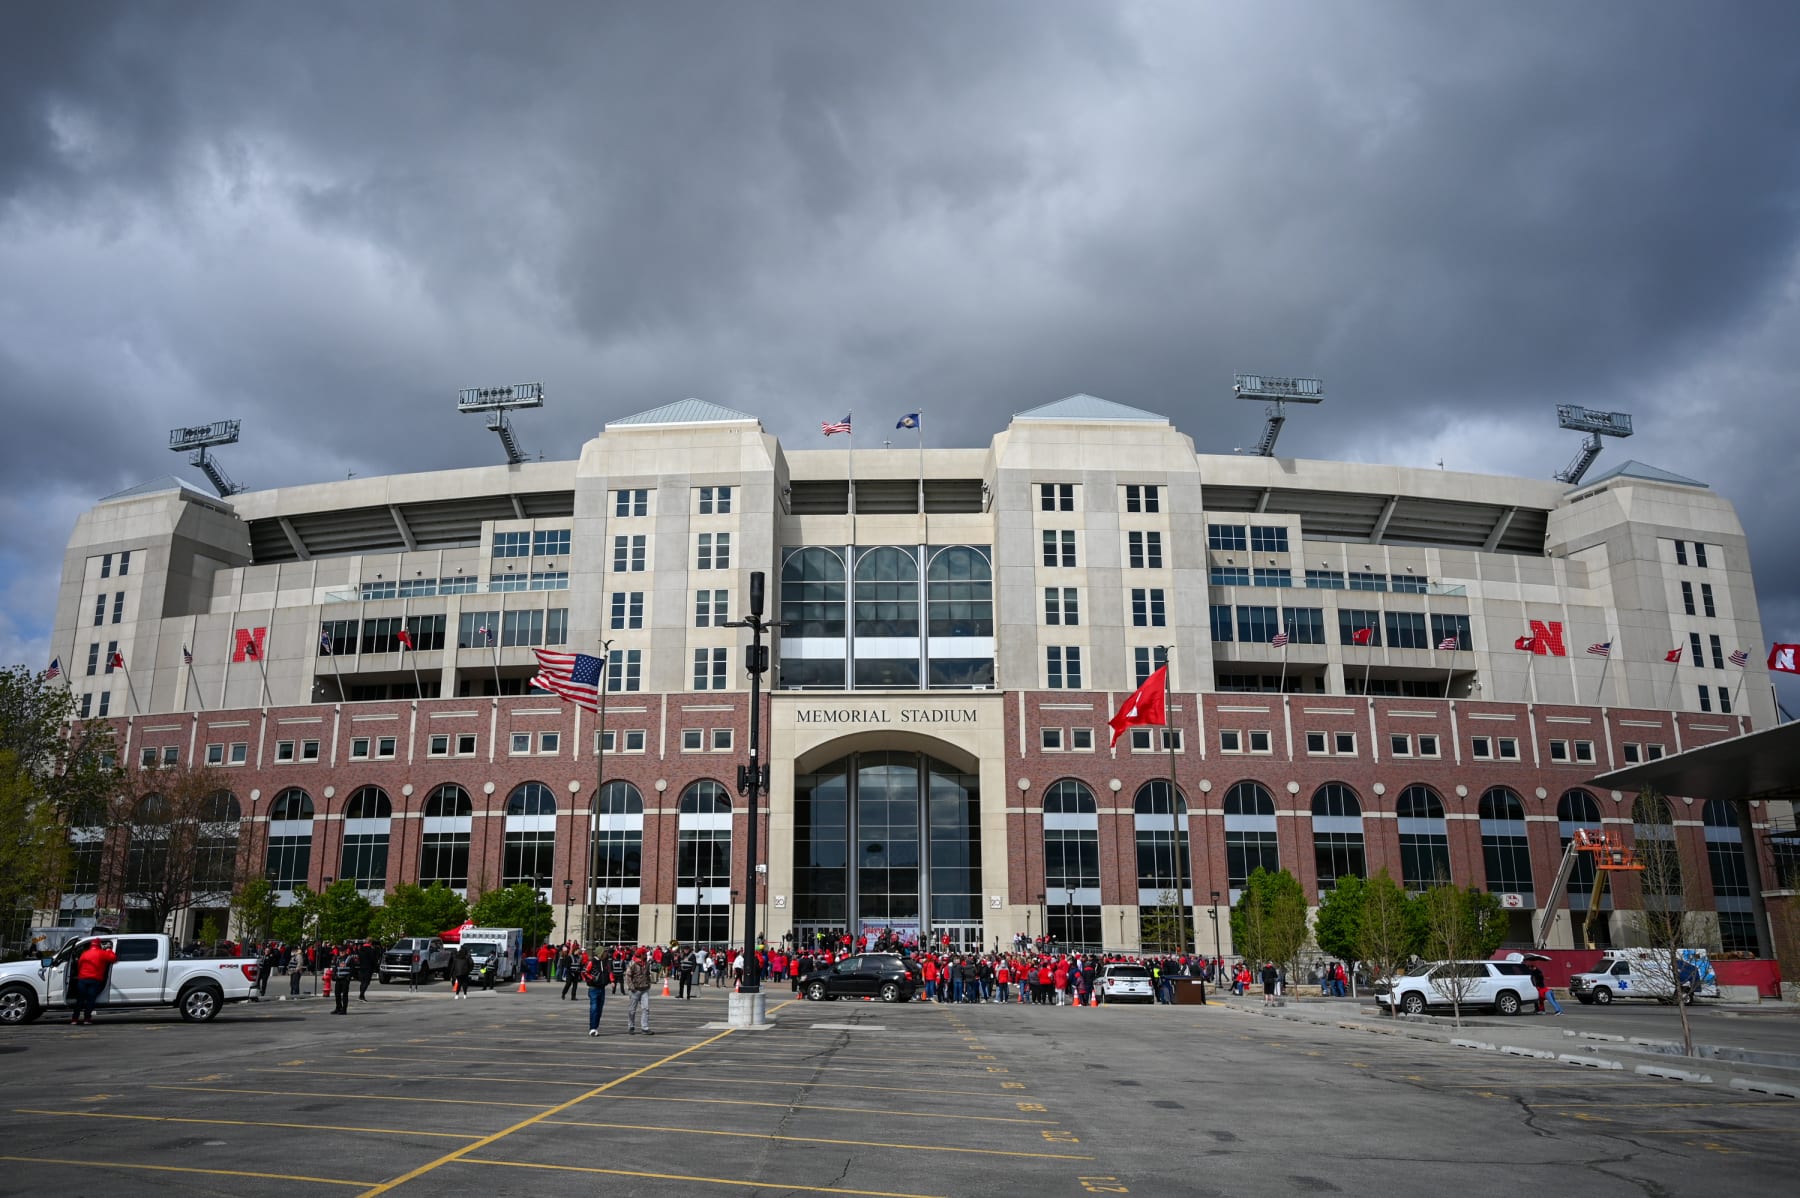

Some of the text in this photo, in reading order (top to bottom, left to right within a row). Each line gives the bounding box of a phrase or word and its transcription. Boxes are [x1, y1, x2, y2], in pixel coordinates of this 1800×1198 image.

[232, 627, 267, 662] N
[1530, 620, 1566, 657] N
[1775, 648, 1796, 670] N
[797, 709, 978, 723] MEMORIAL STADIUM
